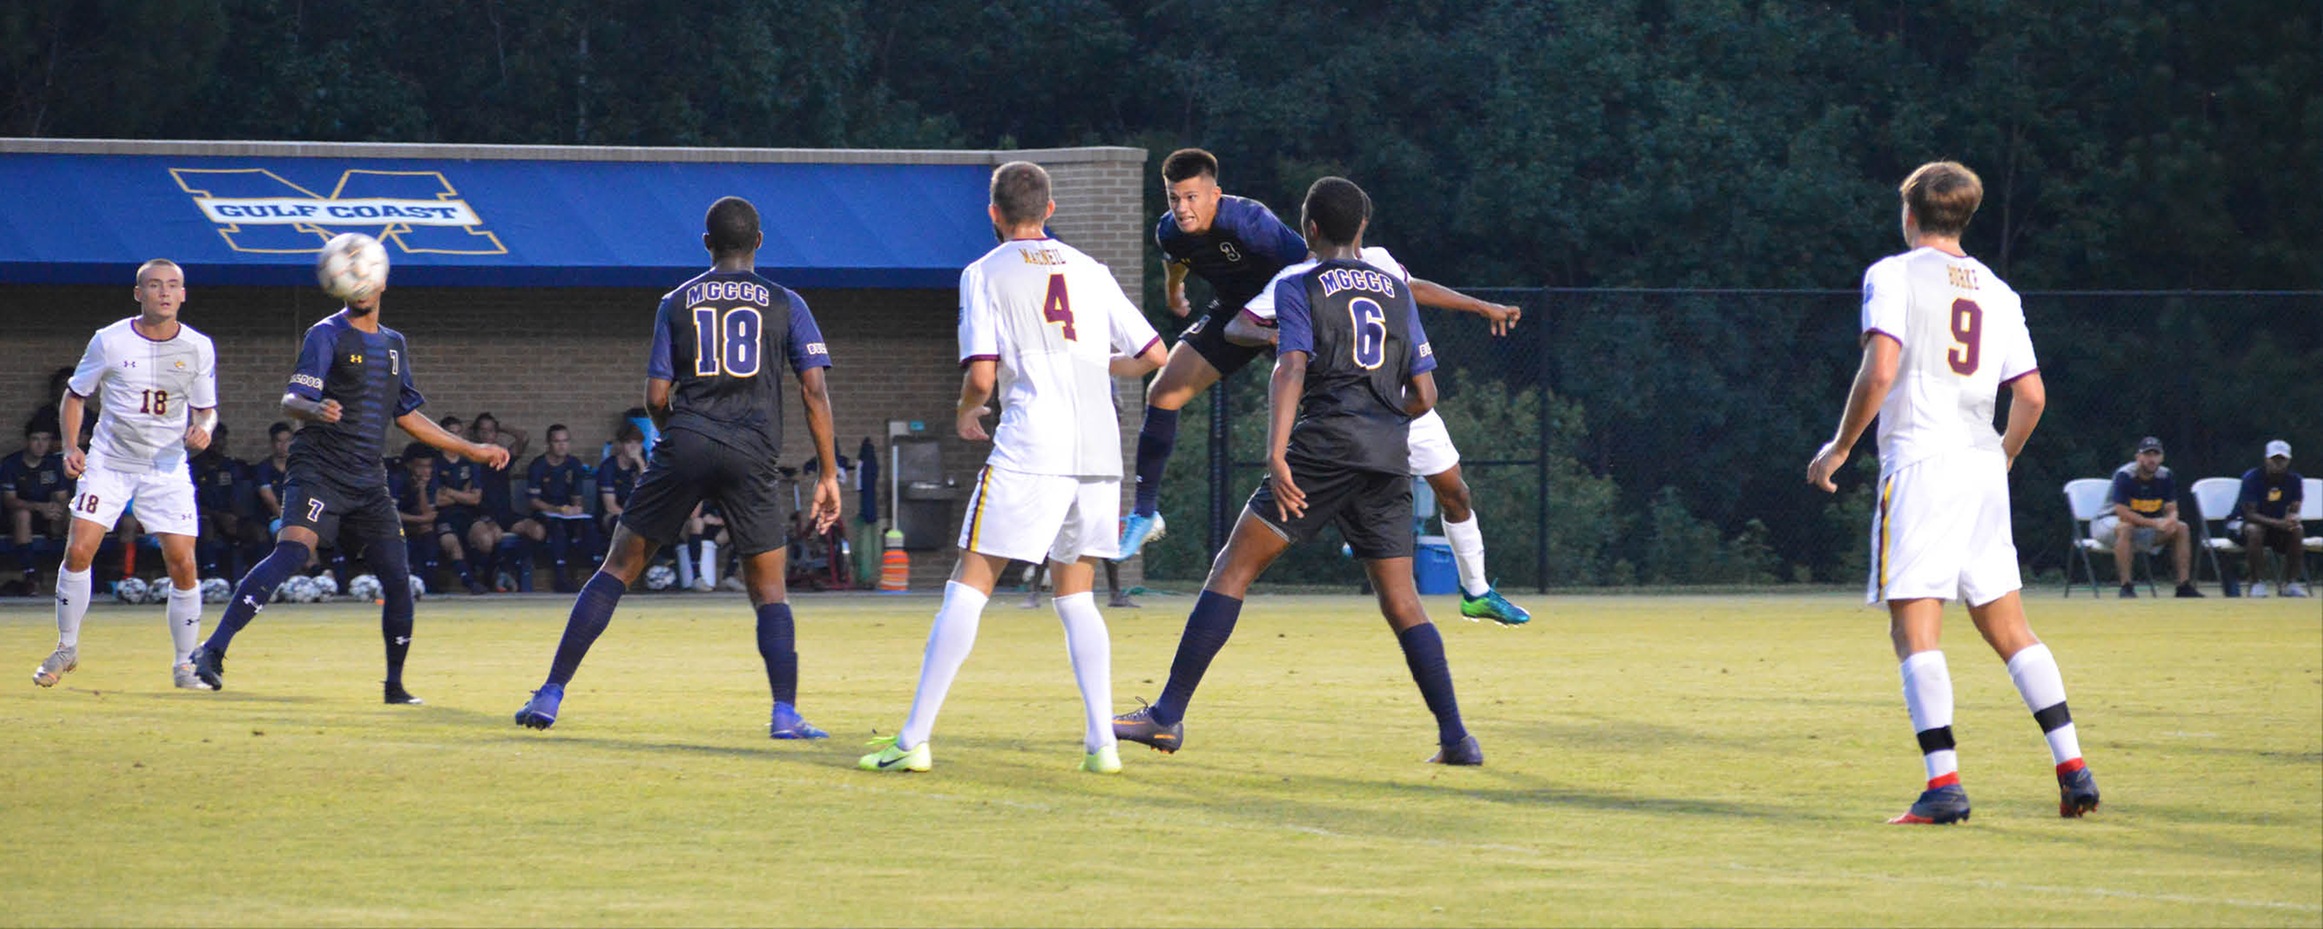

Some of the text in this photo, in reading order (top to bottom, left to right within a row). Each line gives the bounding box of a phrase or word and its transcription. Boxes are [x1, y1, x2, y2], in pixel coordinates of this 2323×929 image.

[213, 204, 459, 219] GULF COAST
[1219, 241, 1241, 262] 3
[686, 281, 769, 309] MGCCC
[1318, 268, 1396, 299] MGCCC
[1043, 273, 1078, 342] 4
[692, 306, 763, 379] 18
[1348, 296, 1386, 370] 6
[1947, 297, 1983, 378] 9
[140, 388, 168, 415] 18
[76, 492, 99, 514] 18
[306, 497, 325, 522] 7
